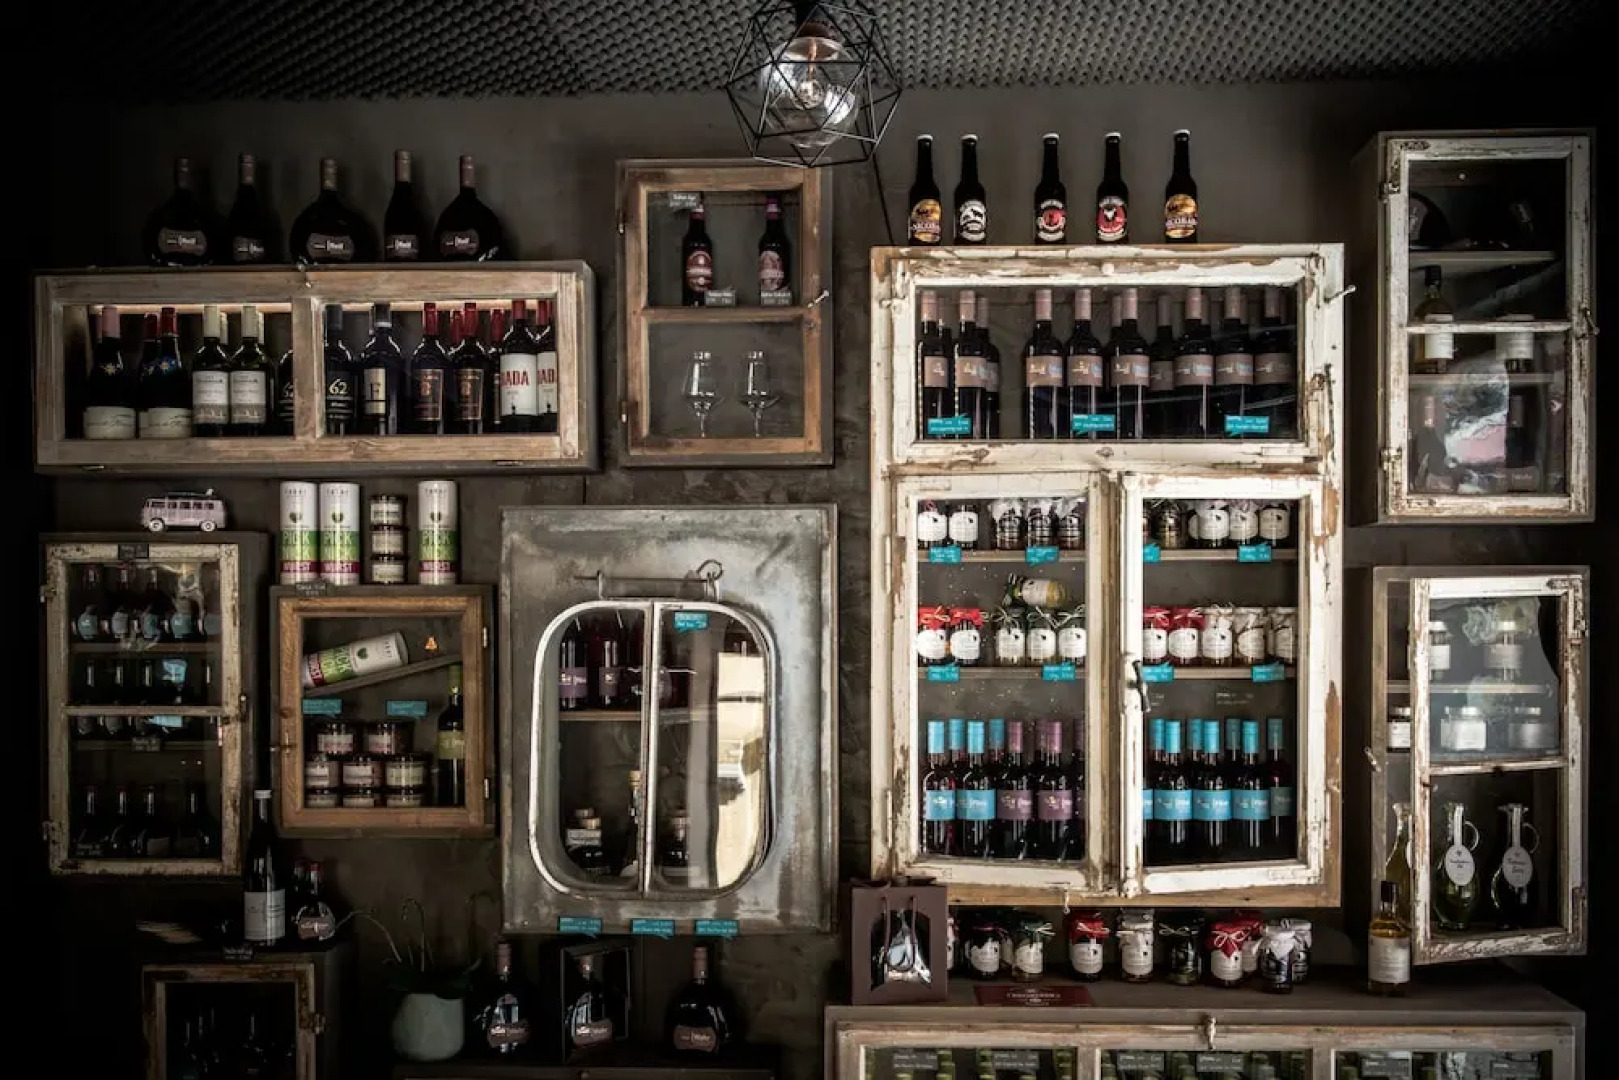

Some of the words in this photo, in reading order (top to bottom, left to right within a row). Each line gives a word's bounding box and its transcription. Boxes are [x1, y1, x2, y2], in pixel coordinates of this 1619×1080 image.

[329, 378, 348, 394] 62
[323, 531, 352, 545] PICK
[422, 530, 451, 545] PICK
